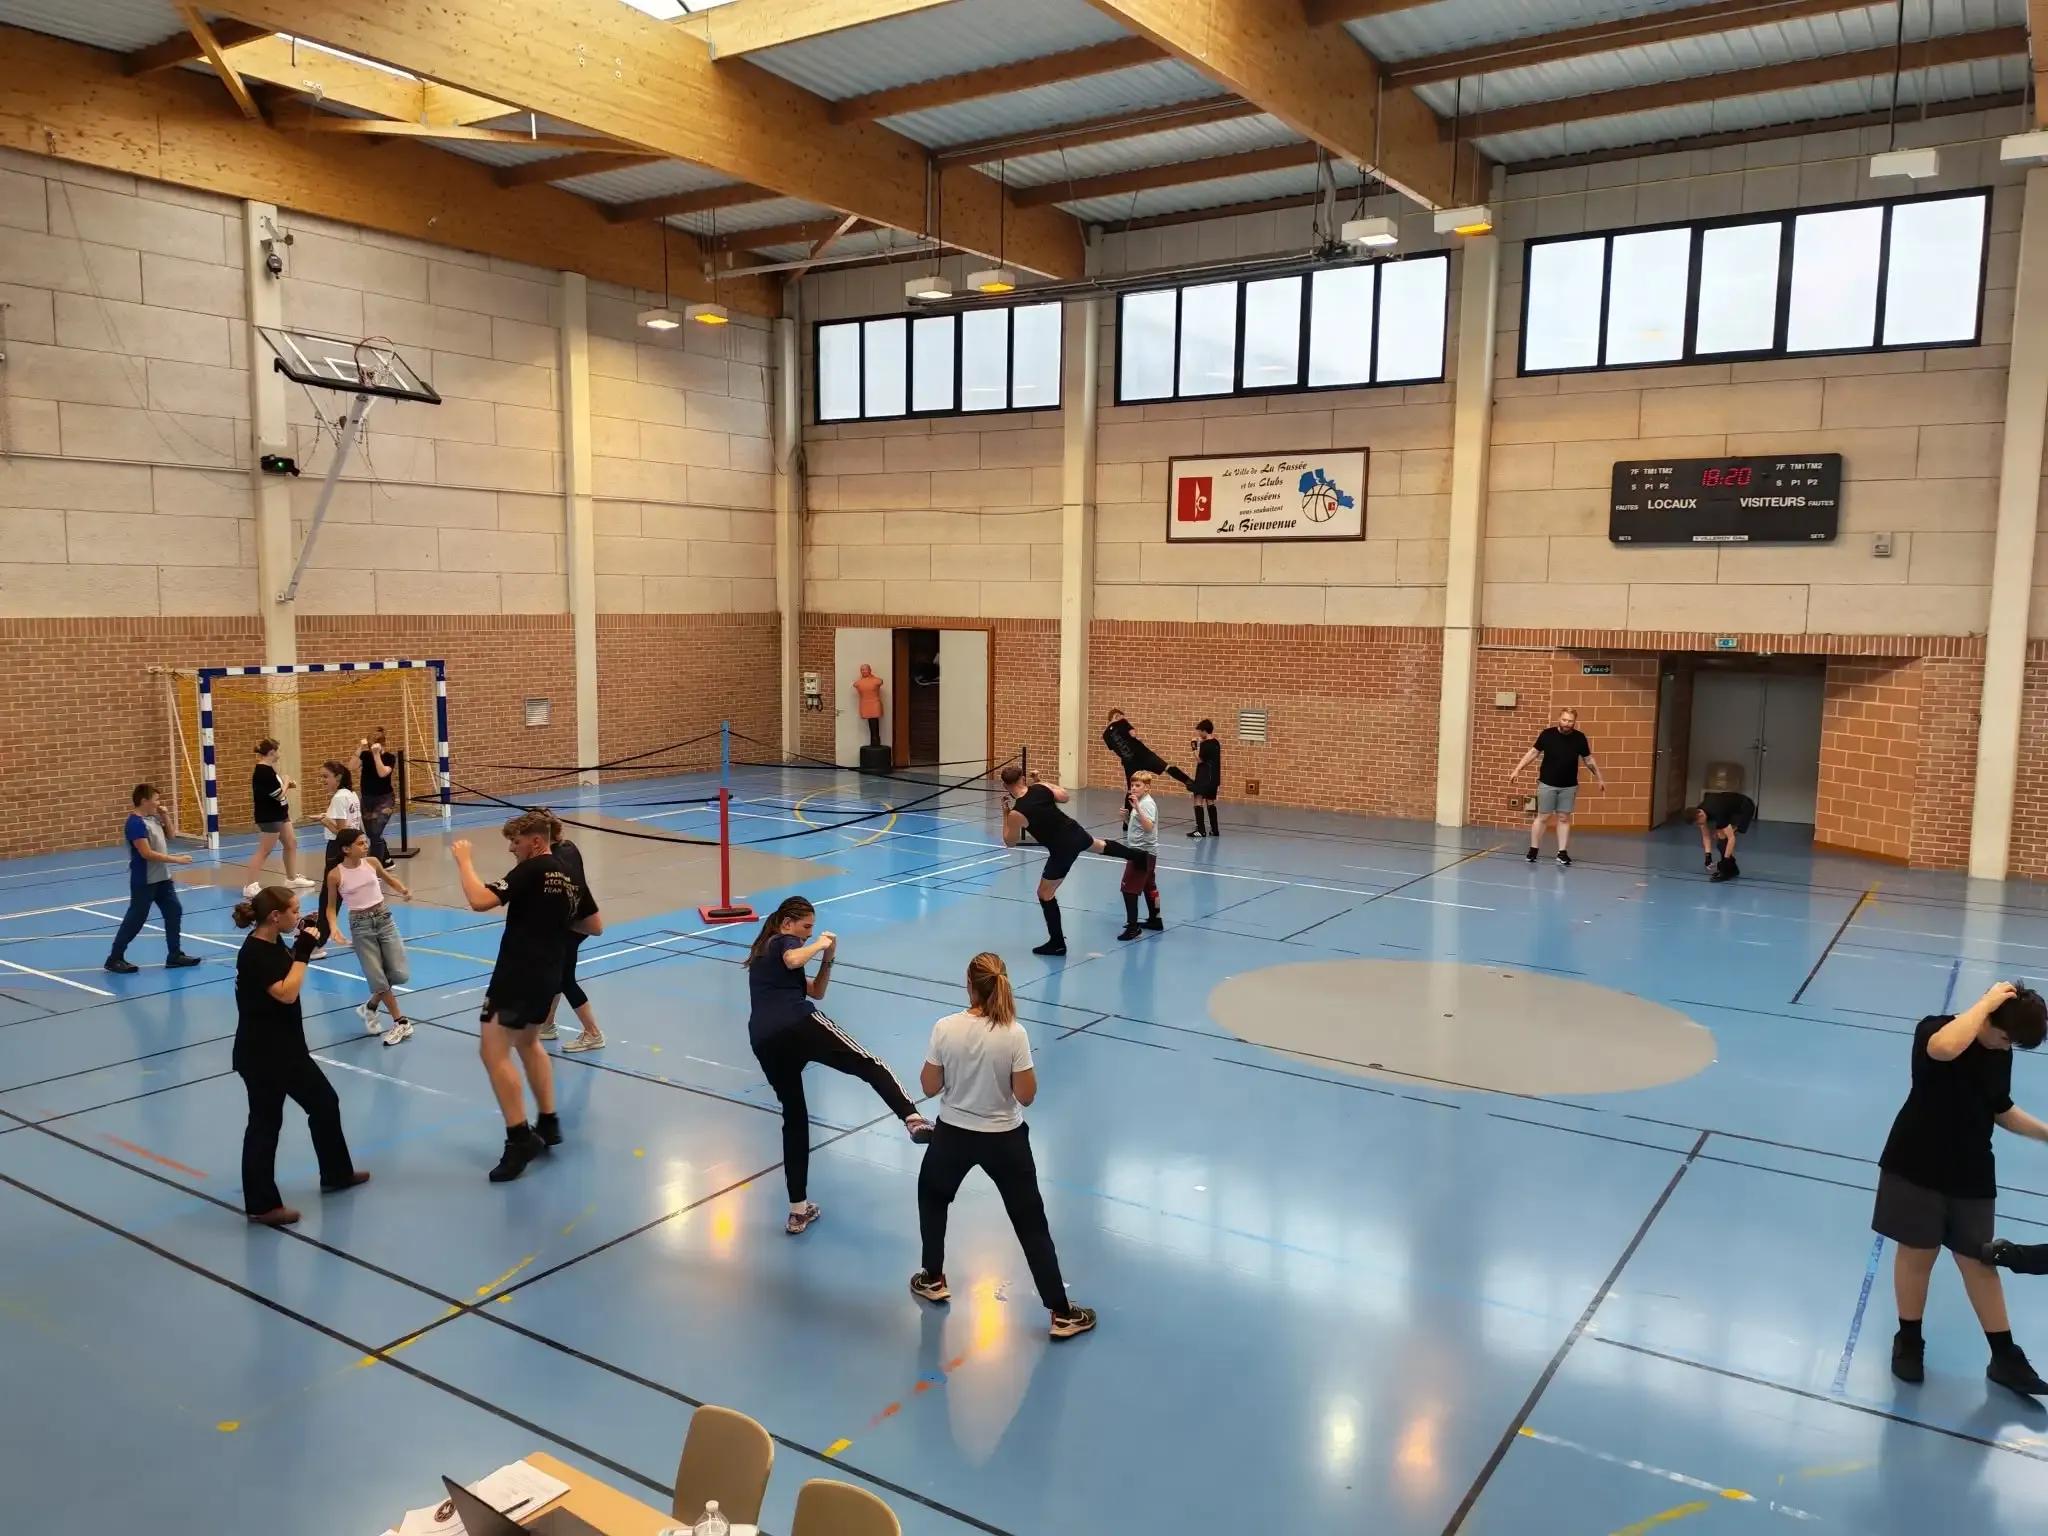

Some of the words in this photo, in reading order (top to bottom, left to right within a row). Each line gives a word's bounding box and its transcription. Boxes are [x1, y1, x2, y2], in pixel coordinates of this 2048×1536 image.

[1233, 468, 1250, 477] Ville
[1260, 463, 1275, 473] La
[1277, 461, 1308, 472] Bassée
[1806, 462, 1823, 470] TM2
[1259, 476, 1284, 487] Clubs
[1702, 467, 1752, 487] 18:20
[1243, 492, 1281, 503] Basséens
[1740, 496, 1806, 508] VISITEURS
[1254, 505, 1283, 514] souhaitent
[1647, 499, 1697, 510] LOCAUX
[1216, 519, 1235, 533] La
[1239, 518, 1297, 532] Bienvenue
